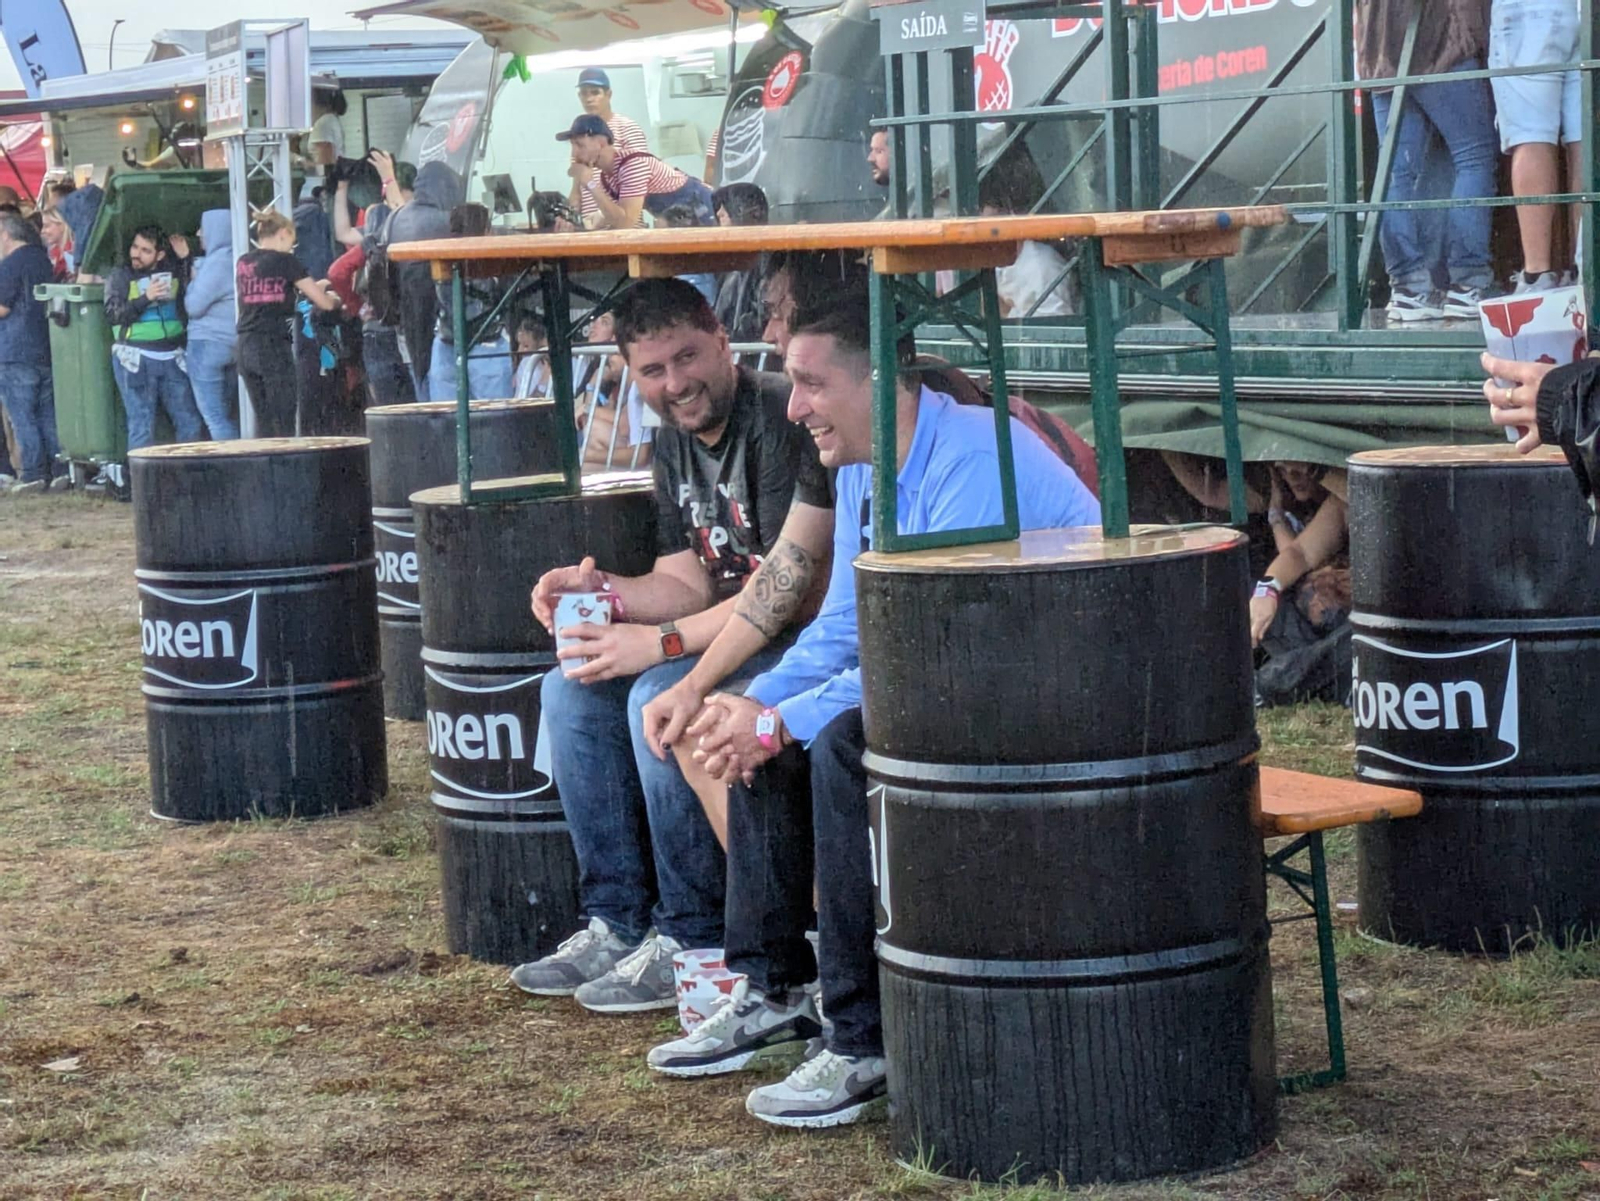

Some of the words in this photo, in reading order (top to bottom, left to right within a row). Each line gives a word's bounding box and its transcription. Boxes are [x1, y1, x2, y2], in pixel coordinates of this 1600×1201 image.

[901, 11, 947, 39] SAÍDA
[1217, 45, 1267, 78] Coren
[140, 616, 235, 658] ORen
